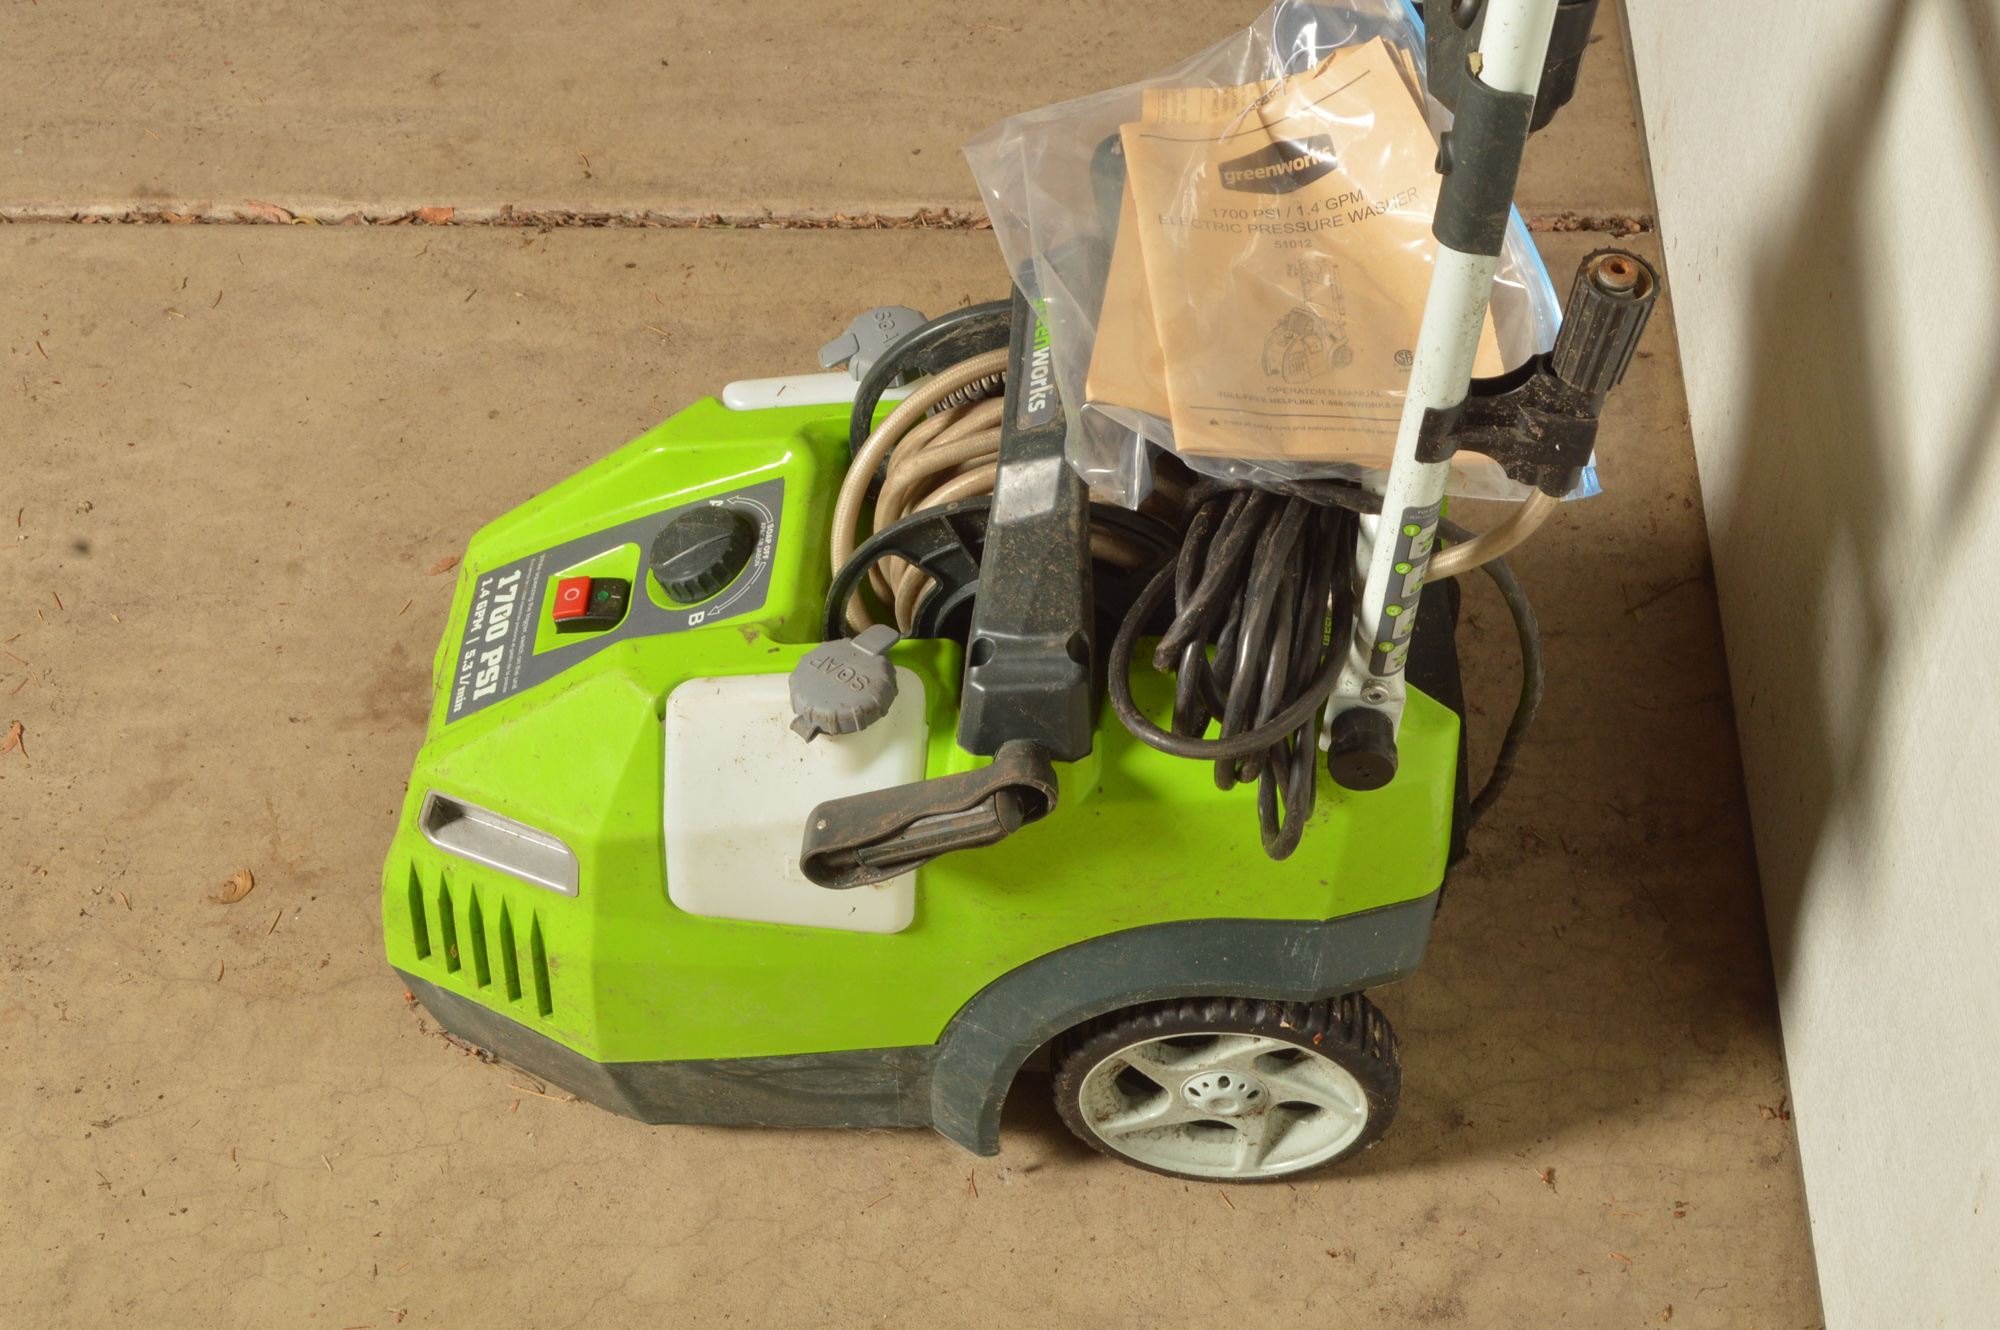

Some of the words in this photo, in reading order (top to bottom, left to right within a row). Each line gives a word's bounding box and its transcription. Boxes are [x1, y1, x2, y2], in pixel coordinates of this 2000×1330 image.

[1223, 146, 1332, 184] greenworks
[1158, 214, 1242, 234] ELECTRIC
[1248, 214, 1344, 234] PRESSURE
[1348, 186, 1420, 224] WASHER
[1211, 208, 1248, 220] 1700
[1253, 208, 1281, 219] PSI
[1297, 202, 1320, 217] 1.4
[1325, 188, 1364, 210] GPM
[1274, 239, 1312, 249] 51012
[873, 311, 900, 348] SOA
[1218, 391, 1267, 403] TOLL-FREE
[1269, 398, 1318, 406] HELPLINE:
[1266, 386, 1336, 397] OPERATOR'S
[1338, 389, 1384, 398] MANUAL
[1307, 425, 1346, 433] instructions
[766, 523, 775, 544] SOAP
[1409, 527, 1415, 536] 1
[536, 553, 546, 571] While
[762, 545, 771, 560] OFF
[1400, 565, 1408, 573] 2
[479, 577, 493, 599] 1.4
[528, 571, 541, 604] squeezing
[485, 570, 521, 642] 1700
[1391, 606, 1399, 615] 3
[471, 599, 488, 633] GPM
[688, 611, 705, 626] B
[518, 634, 526, 656] switch
[1382, 642, 1390, 651] 4
[462, 648, 476, 672] 5.3
[516, 655, 522, 665] on
[472, 644, 505, 701] PSI
[513, 664, 521, 677] the
[810, 656, 870, 692] SOAP
